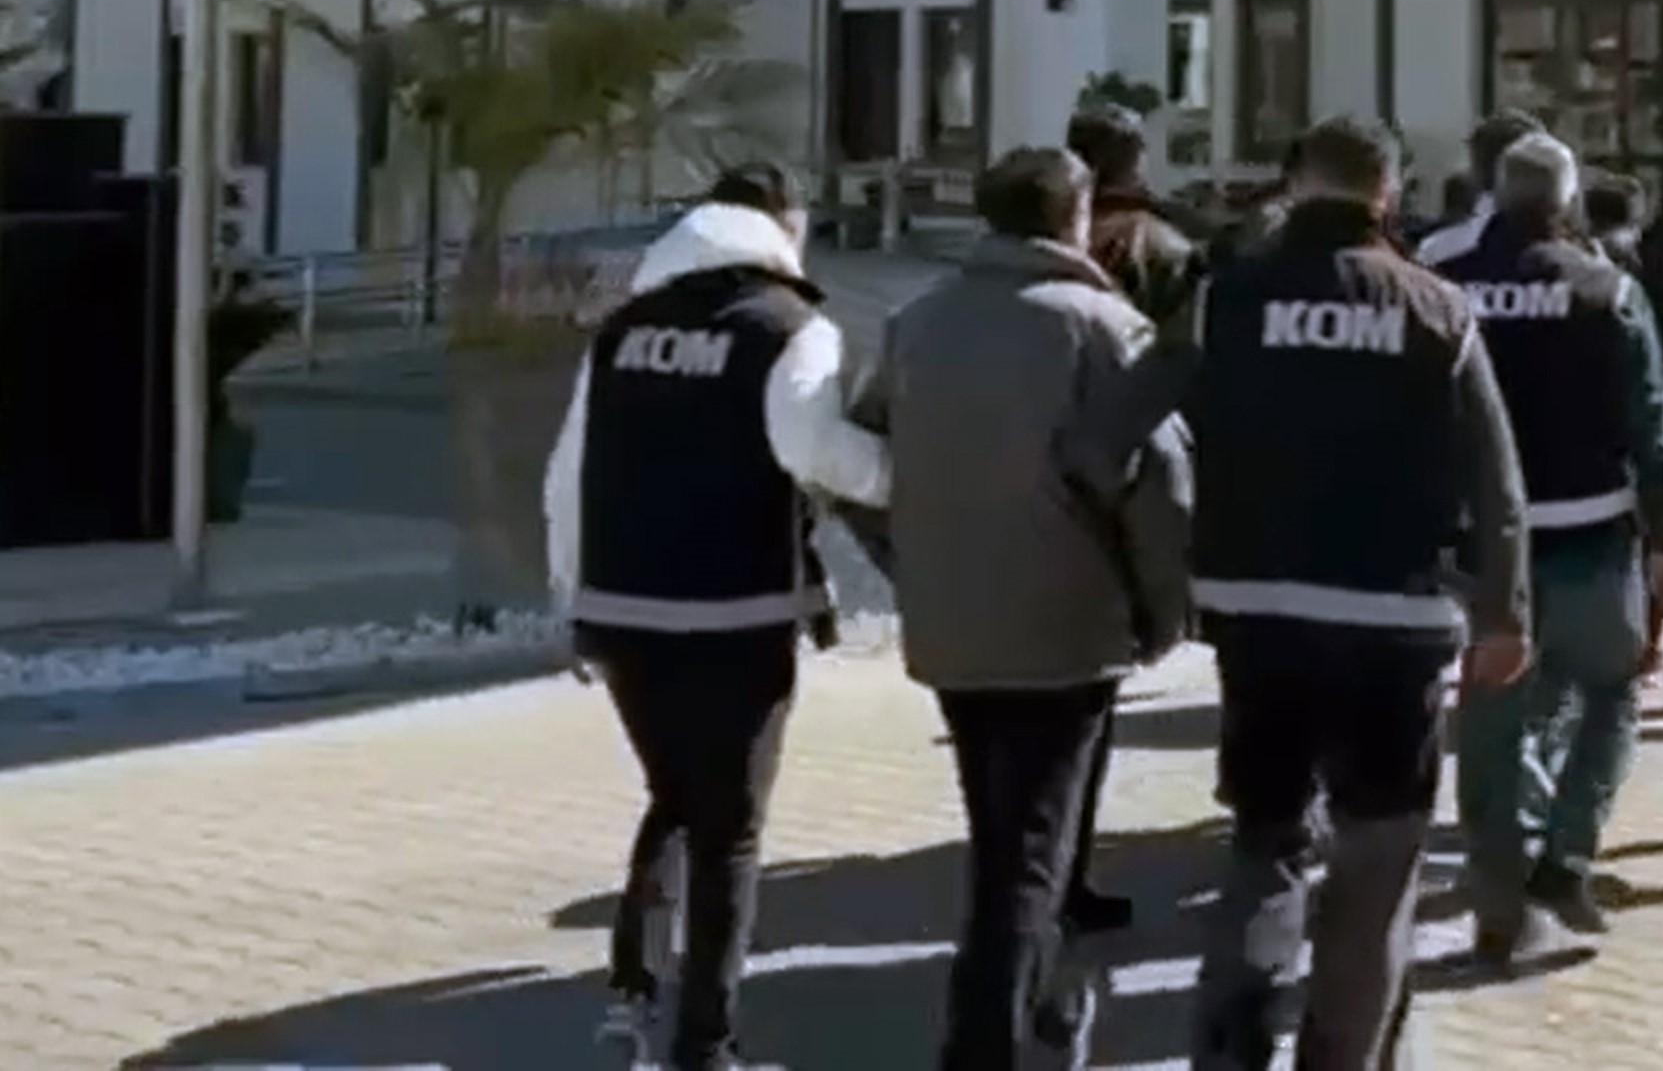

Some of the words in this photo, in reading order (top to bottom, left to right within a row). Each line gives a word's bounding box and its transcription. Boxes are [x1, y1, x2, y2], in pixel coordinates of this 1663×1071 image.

[1464, 279, 1573, 321] KOM
[614, 327, 735, 378] KOM
[1260, 299, 1408, 355] KOM
